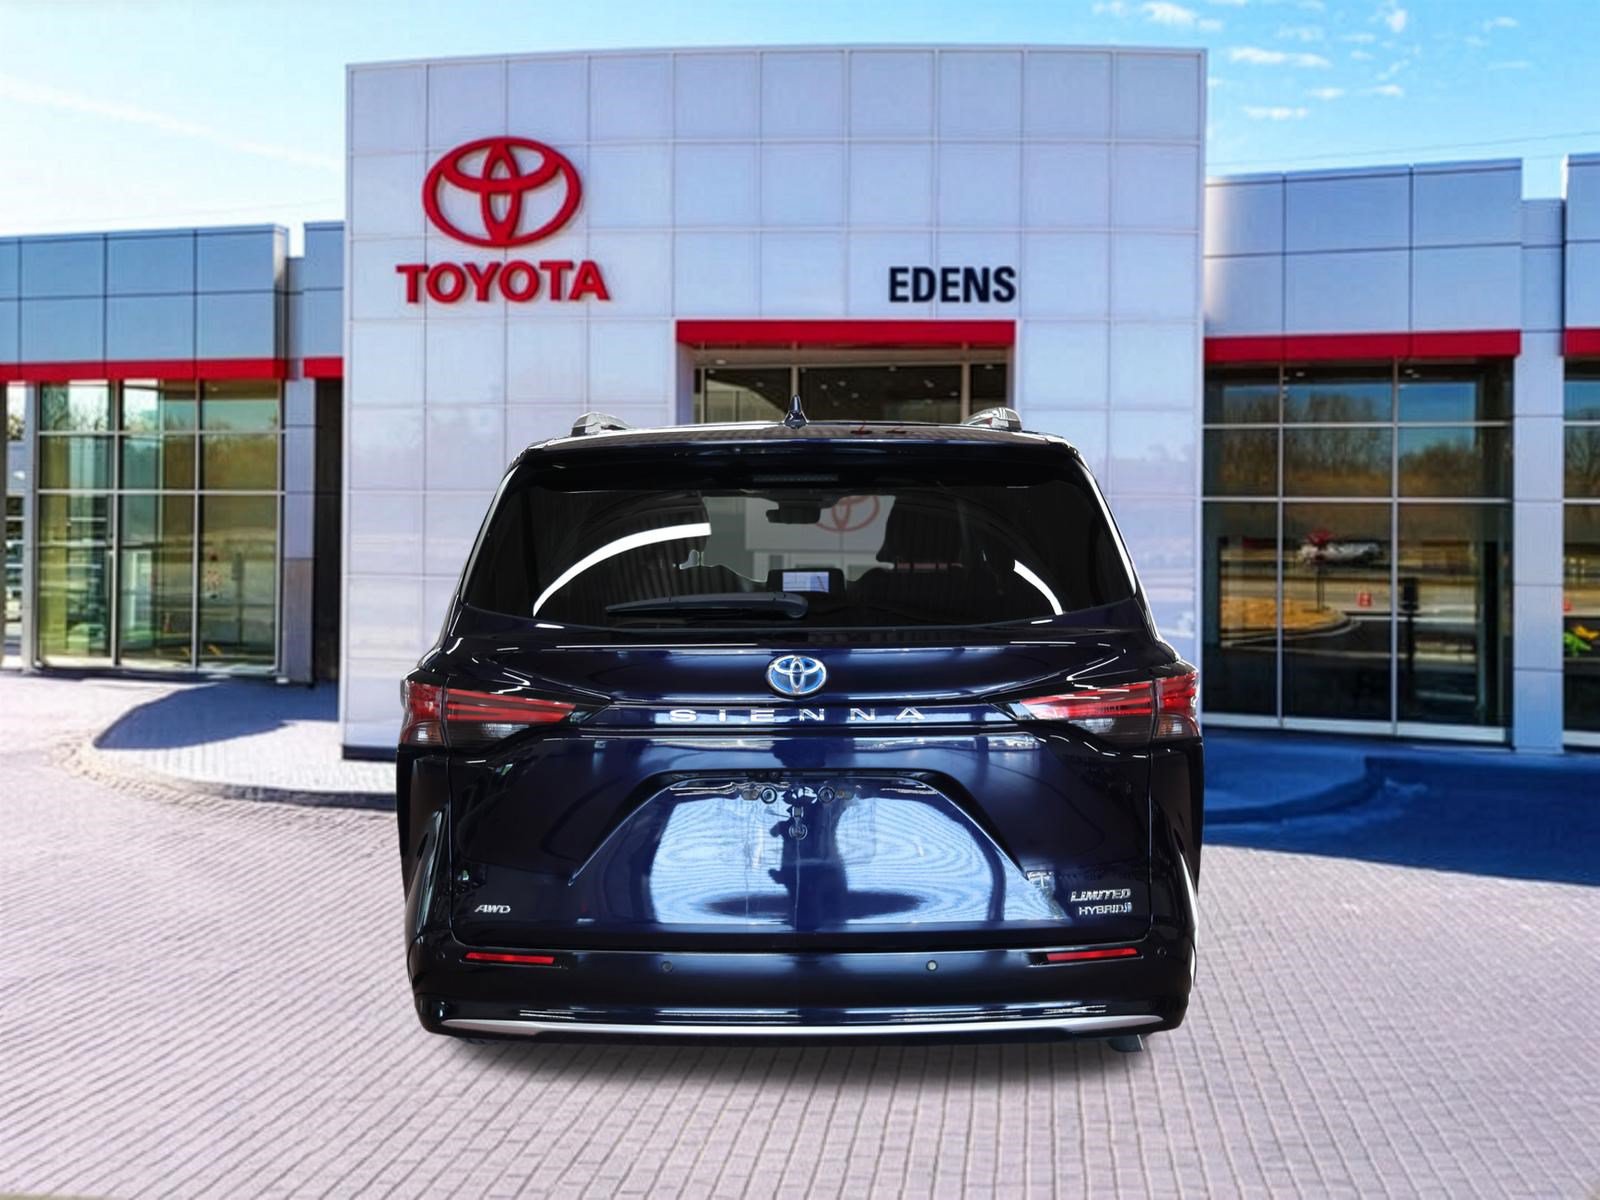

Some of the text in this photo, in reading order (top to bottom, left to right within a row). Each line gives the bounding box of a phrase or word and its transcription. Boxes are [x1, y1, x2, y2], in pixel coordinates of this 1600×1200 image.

[396, 260, 610, 303] TOYOTA
[889, 266, 1017, 303] EDENS
[669, 707, 925, 722] SIENNA
[1070, 888, 1131, 902] LIMITED
[474, 904, 511, 914] AWD
[1078, 903, 1125, 916] HYBRID
